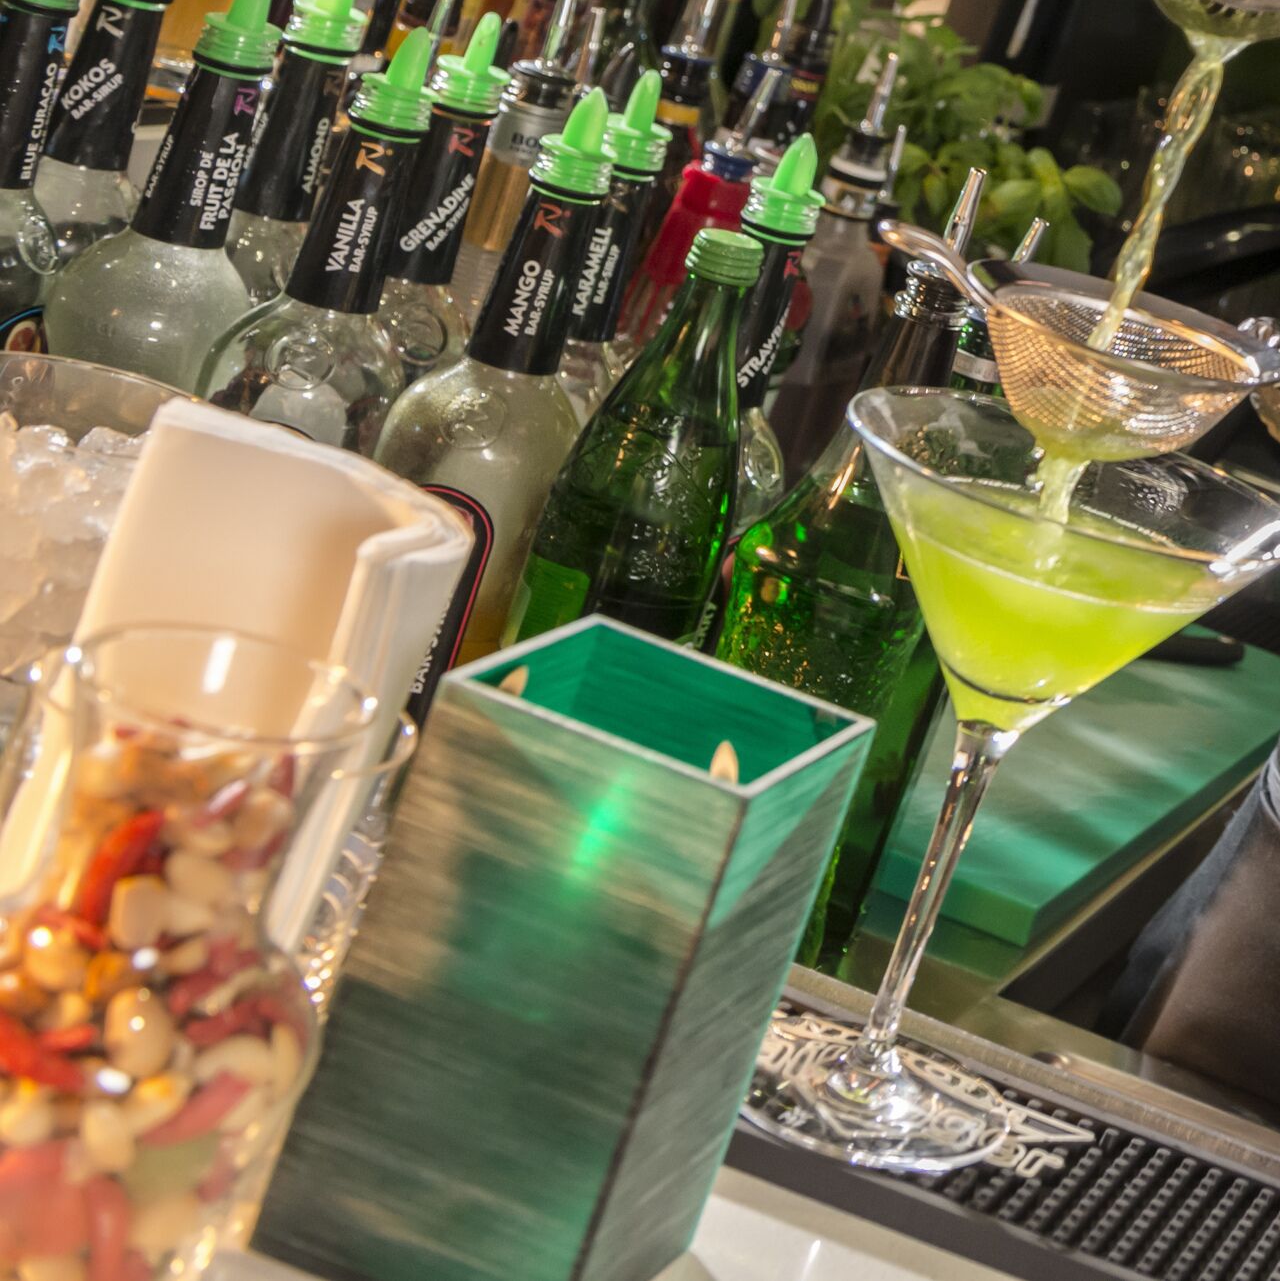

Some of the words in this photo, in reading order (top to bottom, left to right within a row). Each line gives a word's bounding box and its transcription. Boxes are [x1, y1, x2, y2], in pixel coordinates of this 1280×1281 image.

[60, 58, 117, 110] KOKOS
[70, 73, 124, 120] BAR-SIRUP
[20, 142, 38, 180] BLUE
[199, 150, 215, 169] DE
[212, 158, 232, 181] DE
[219, 131, 240, 155] LA
[301, 117, 330, 194] ALMOND
[189, 169, 210, 208] SIROP
[199, 182, 224, 231] FRUIT
[218, 144, 247, 220] PASSION
[399, 172, 475, 252] GRENADINE
[325, 198, 366, 272] VANILLA
[348, 205, 379, 274] BAR-SYRUP
[503, 259, 541, 337] MANGO
[571, 226, 613, 317] KARAMELL
[524, 269, 555, 337] BAR-SYRUP
